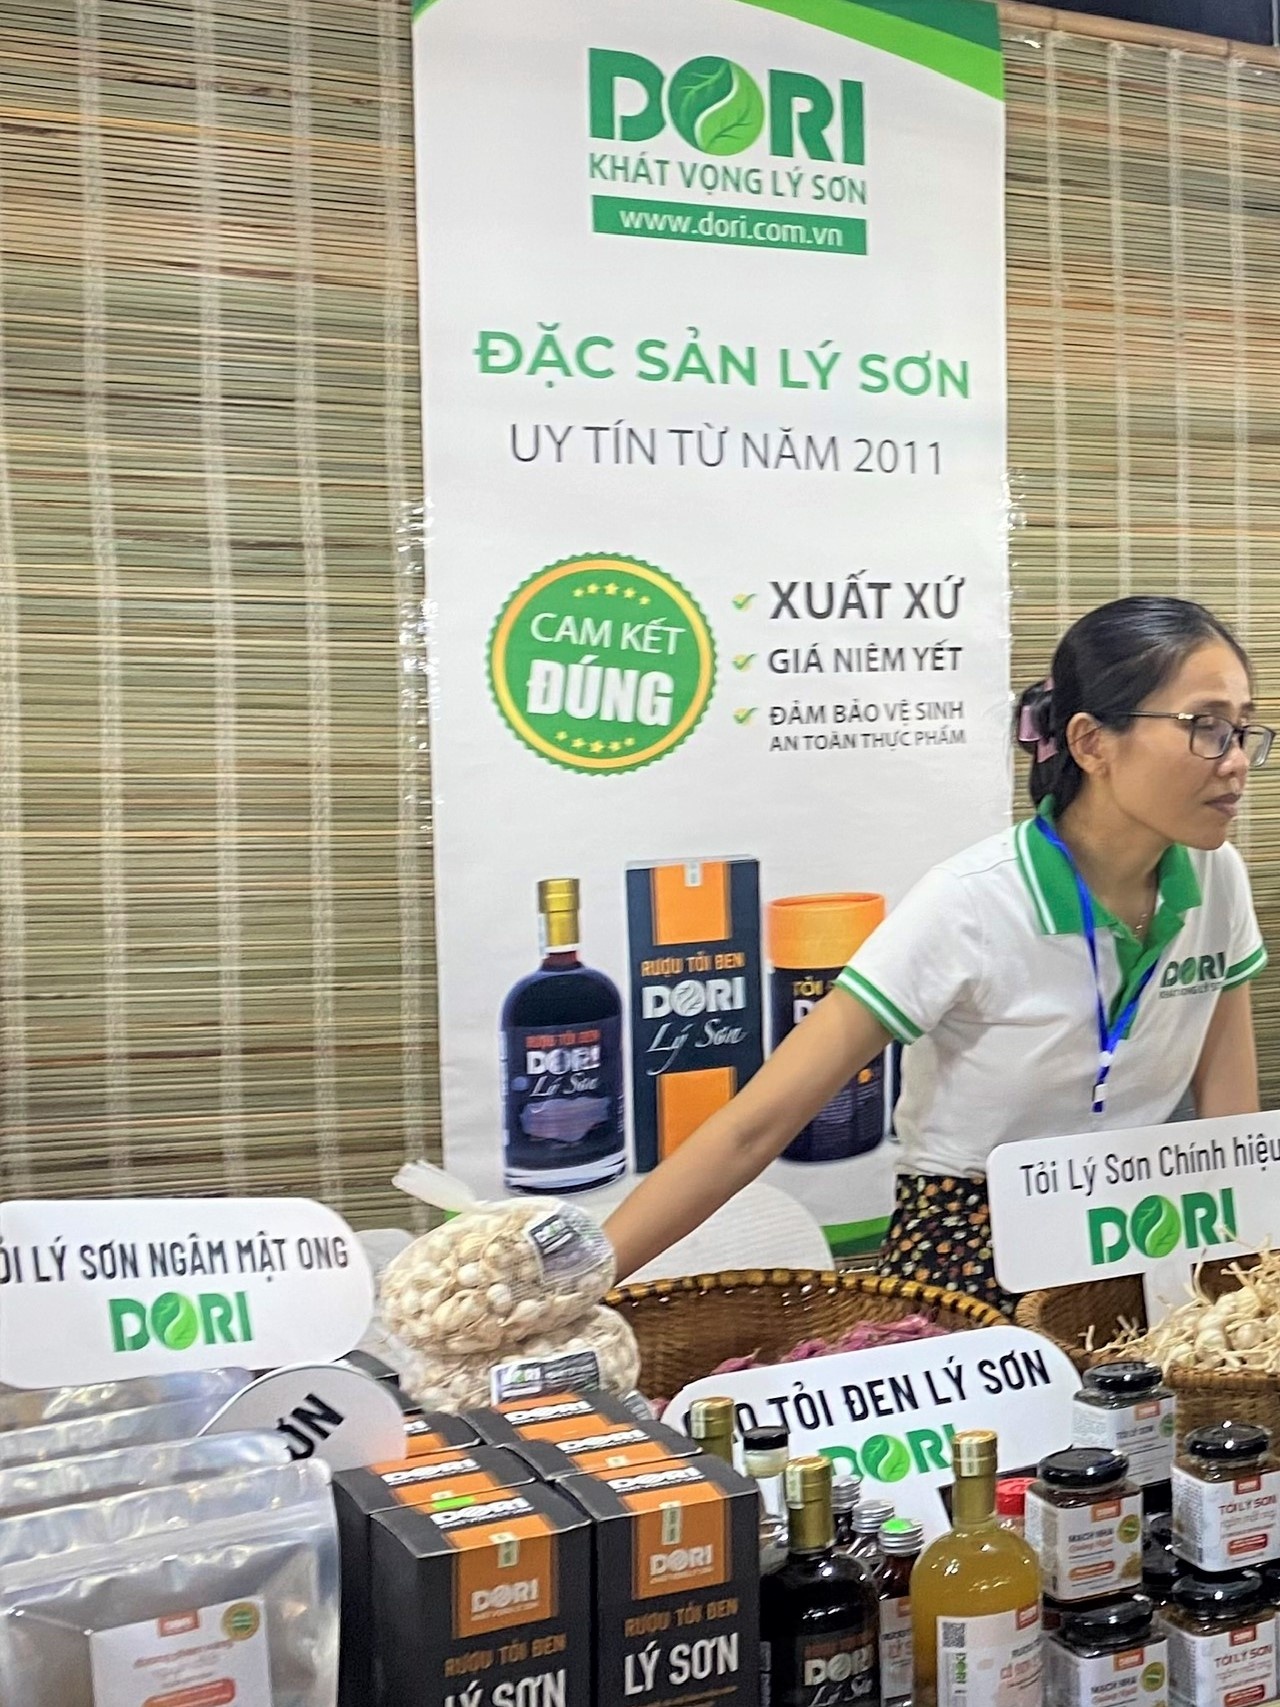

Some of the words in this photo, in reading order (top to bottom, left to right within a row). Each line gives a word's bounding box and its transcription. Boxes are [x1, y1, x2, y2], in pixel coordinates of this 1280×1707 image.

[588, 47, 866, 166] DORI
[588, 152, 669, 187] KHÁT
[681, 162, 763, 196] VỌNG
[771, 166, 804, 196] LÝ
[812, 175, 867, 205] SƠN
[619, 206, 844, 248] www.dori.com.vn
[473, 322, 615, 388] ĐẶC
[636, 327, 757, 387] SẢN
[780, 340, 842, 391] LÝ
[859, 351, 971, 399] SƠN
[510, 423, 574, 462] UY
[583, 419, 656, 466] TÍN
[668, 422, 731, 467] TỪ
[741, 426, 840, 472] NĂM
[853, 438, 942, 475] 2011
[769, 569, 891, 620] XUẤT
[904, 575, 965, 619] XỨ
[530, 612, 611, 649] CAM
[620, 616, 686, 656] KẾT
[768, 644, 824, 674] GIÁ
[833, 646, 905, 673] NIÊM
[911, 639, 963, 672] YẾT
[527, 656, 674, 727] ĐÚNG
[769, 700, 826, 726] ĐẢM
[832, 698, 880, 724] BẢO
[884, 699, 910, 726] VỆ
[915, 701, 964, 721] SINH
[769, 735, 799, 752] AN
[802, 730, 856, 751] TOÀN
[860, 729, 913, 752] THỰC
[914, 724, 967, 745] PHẨM
[1161, 951, 1226, 988] DORI
[642, 976, 747, 1020] DORI
[645, 1022, 695, 1076] Lý
[1020, 1159, 1059, 1197] Tỏi
[1068, 1156, 1097, 1197] Lý
[1105, 1153, 1151, 1185] Sơn
[1158, 1139, 1226, 1178] Chính
[1086, 1187, 1238, 1266] DORI
[0, 1236, 23, 1284] ỎI
[32, 1235, 67, 1284] LÝ
[80, 1240, 140, 1280] SƠN
[150, 1232, 229, 1277] NGÂM
[235, 1230, 288, 1283] MẬT
[297, 1235, 349, 1270] ONG
[108, 1291, 255, 1353] DORI
[766, 1380, 834, 1431] TỎI
[840, 1373, 920, 1423] ĐEN
[924, 1354, 968, 1406] LÝ
[979, 1348, 1052, 1395] SƠN
[277, 1393, 345, 1461] ƠN
[650, 1543, 714, 1576] DORI
[470, 1577, 540, 1614] DORI
[624, 1639, 662, 1697] LÝ
[668, 1631, 740, 1686] SƠN
